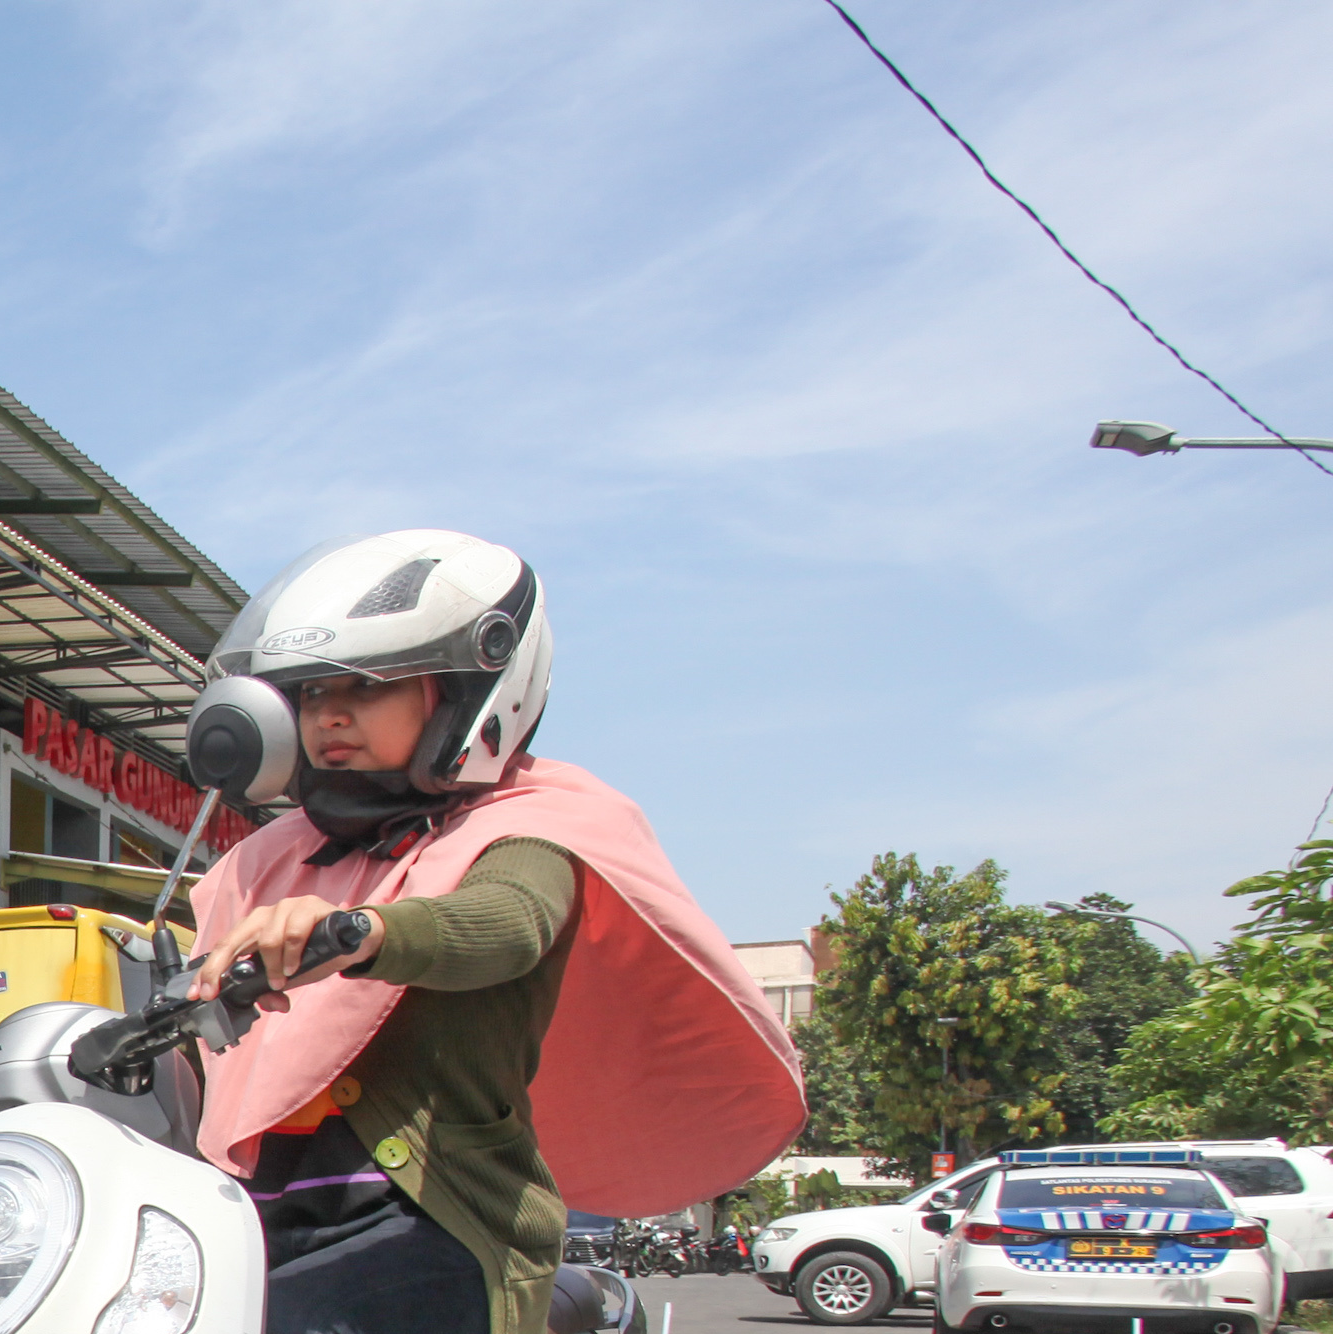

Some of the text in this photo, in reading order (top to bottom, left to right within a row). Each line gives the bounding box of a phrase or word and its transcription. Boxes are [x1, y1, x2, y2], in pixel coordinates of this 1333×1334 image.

[271, 632, 318, 649] ZEUS
[23, 697, 114, 794] PASAR
[1052, 1184, 1167, 1196] SIKATAN 9
